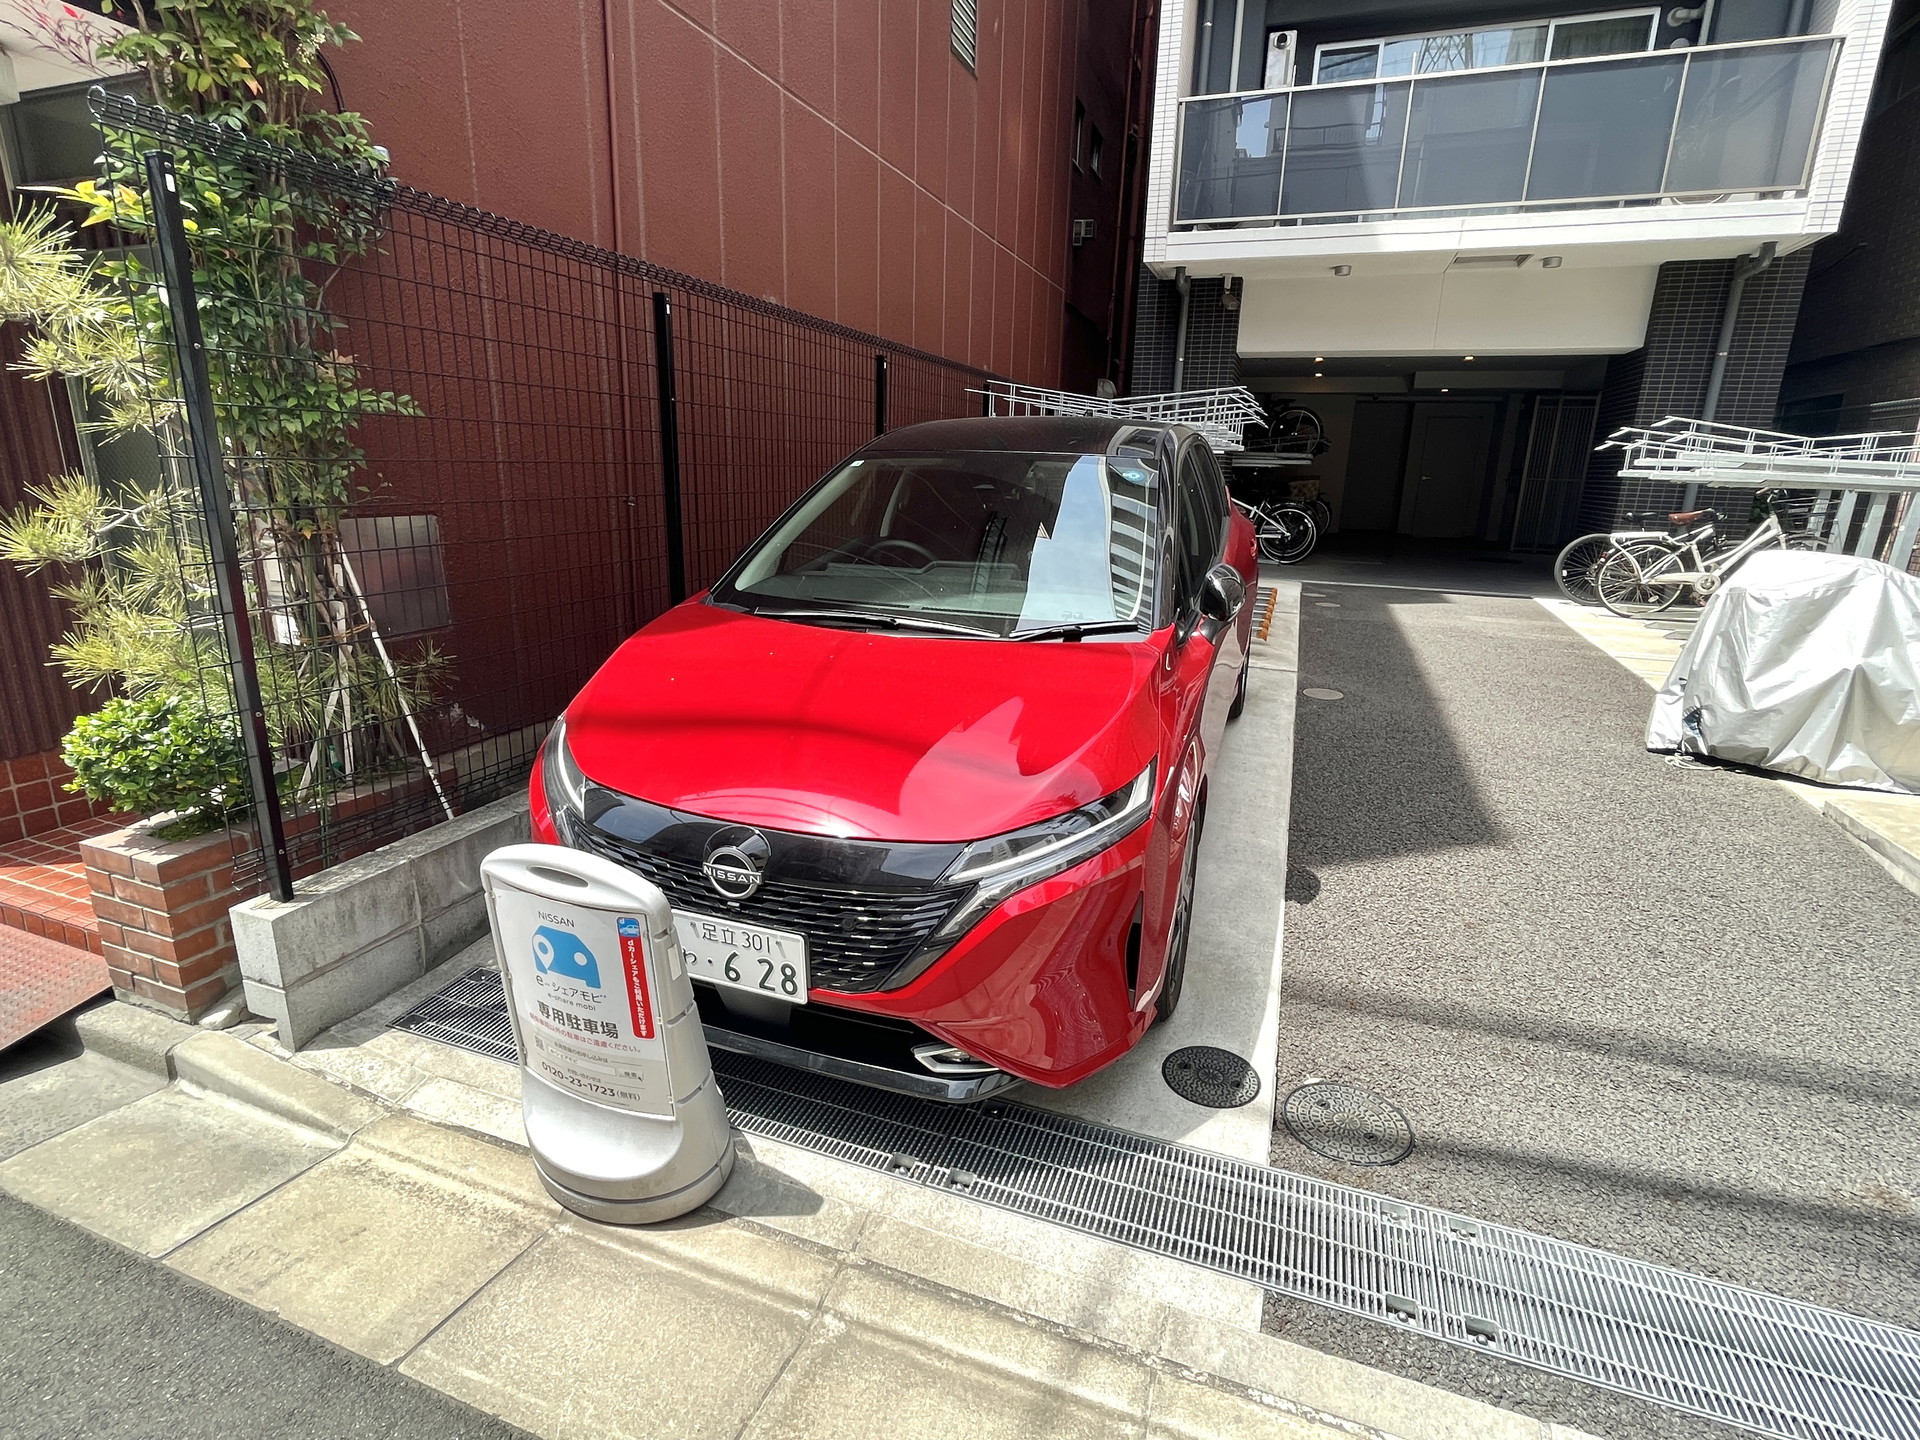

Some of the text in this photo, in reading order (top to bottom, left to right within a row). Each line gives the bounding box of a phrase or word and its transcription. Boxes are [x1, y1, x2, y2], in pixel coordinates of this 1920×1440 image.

[703, 865, 760, 884] NISSAN
[538, 911, 575, 927] NISSAN
[702, 922, 771, 954] 足立 301
[547, 992, 596, 1011] e-share mobi
[537, 1000, 619, 1040] 専用駐車場
